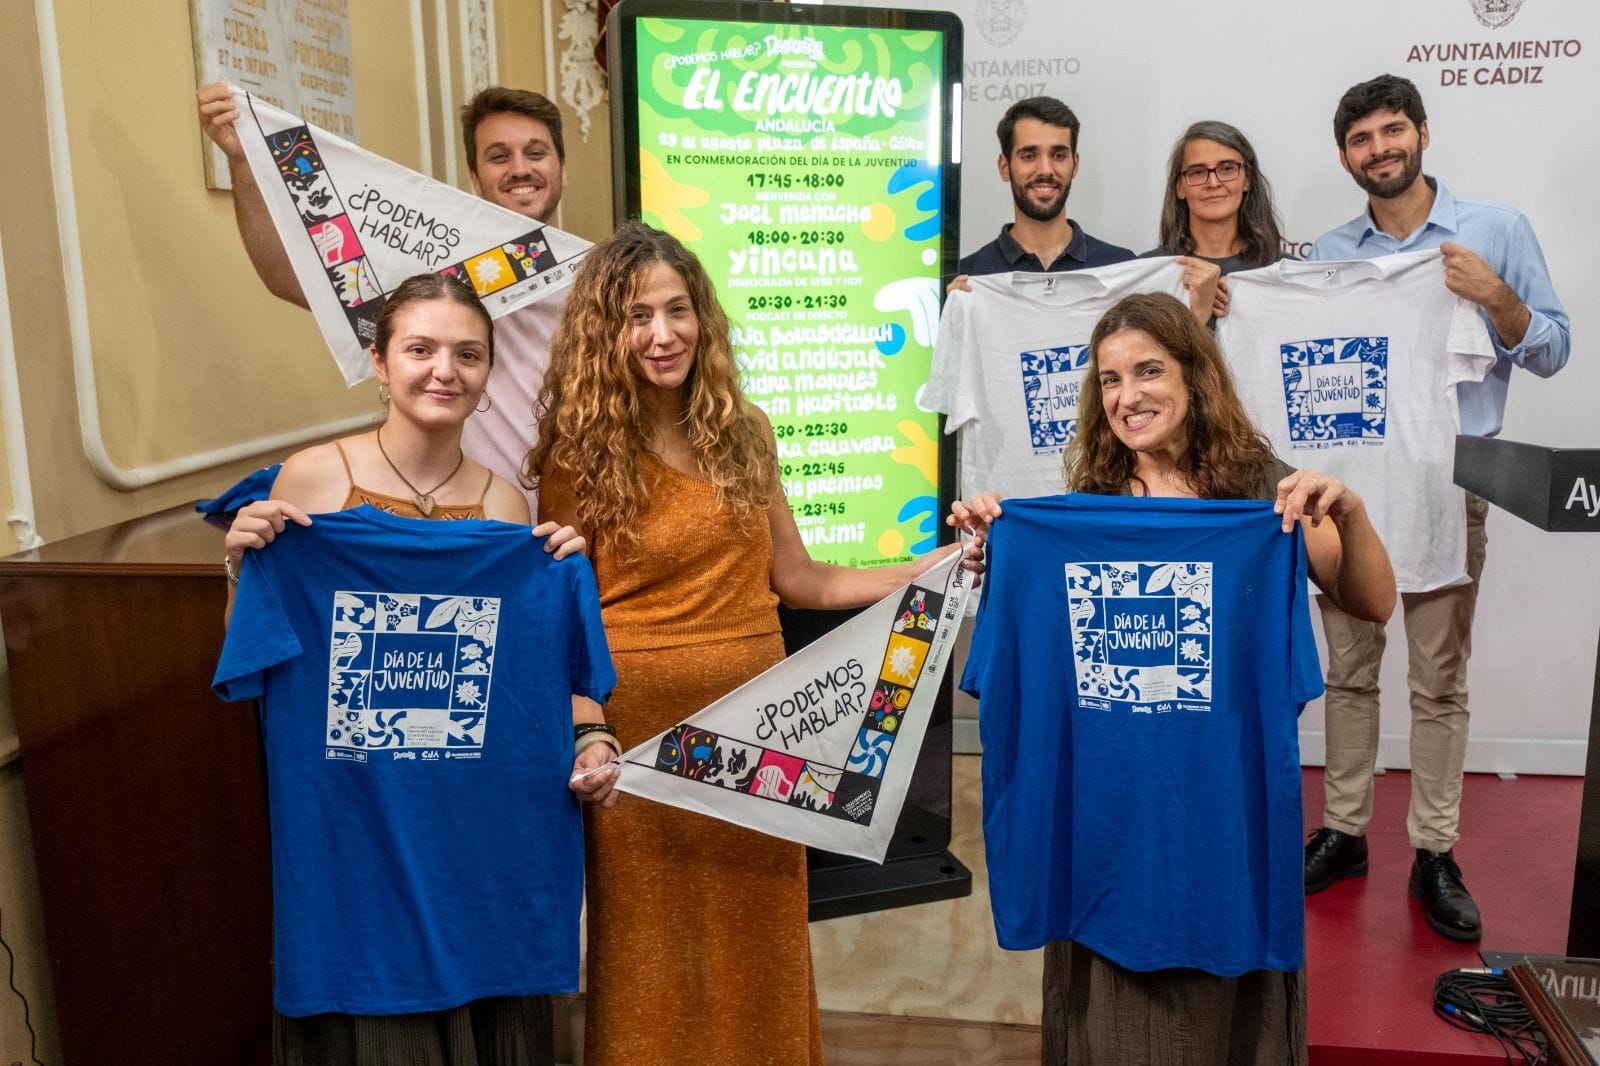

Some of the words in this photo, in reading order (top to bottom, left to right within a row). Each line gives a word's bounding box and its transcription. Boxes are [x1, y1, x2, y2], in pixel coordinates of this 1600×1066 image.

[1406, 39, 1582, 63] AYUNTAMIENTO
[964, 57, 1081, 78] NTAMIENTO
[1440, 68, 1468, 87] DE
[1473, 62, 1544, 86] CÁDIZ
[682, 68, 723, 110] EL
[983, 79, 1047, 101] CÁDIZ
[755, 118, 836, 133] ANDALUCÍA
[667, 155, 681, 164] EN
[684, 154, 786, 166] CONMEMORACIÓN
[789, 157, 808, 166] DEL
[811, 154, 829, 166] DÍA
[833, 157, 845, 166] DE
[849, 158, 861, 166] LA
[864, 158, 917, 167] JUVENTUD
[746, 173, 792, 188] 17:45
[803, 173, 844, 188] 18:00
[348, 184, 461, 248] ¿PODEMOS
[359, 214, 451, 271] HABLAR?
[747, 230, 790, 245] 18:00
[800, 230, 844, 245] 20:30
[748, 296, 792, 310] 20:30
[804, 294, 847, 309] 21:30
[1070, 382, 1079, 392] DE
[1317, 376, 1330, 388] DÍA
[1332, 376, 1341, 387] DE
[1344, 375, 1354, 386] LA
[1053, 396, 1080, 410] JUVE
[1312, 386, 1360, 403] JUVENTUD
[805, 422, 848, 437] 22:30
[802, 462, 845, 476] 22:45
[804, 503, 845, 516] 23:45
[1114, 612, 1132, 630] DÍA
[1134, 614, 1149, 630] DE
[1152, 614, 1165, 629] LA
[1107, 630, 1174, 650] JUVENTUD
[383, 650, 404, 669] DÍA
[407, 651, 425, 669] DE
[428, 652, 443, 668] LA
[374, 670, 450, 692] JUVENTUD
[756, 659, 863, 740] ¿PODEMOS
[780, 681, 866, 750] HABLAR?
